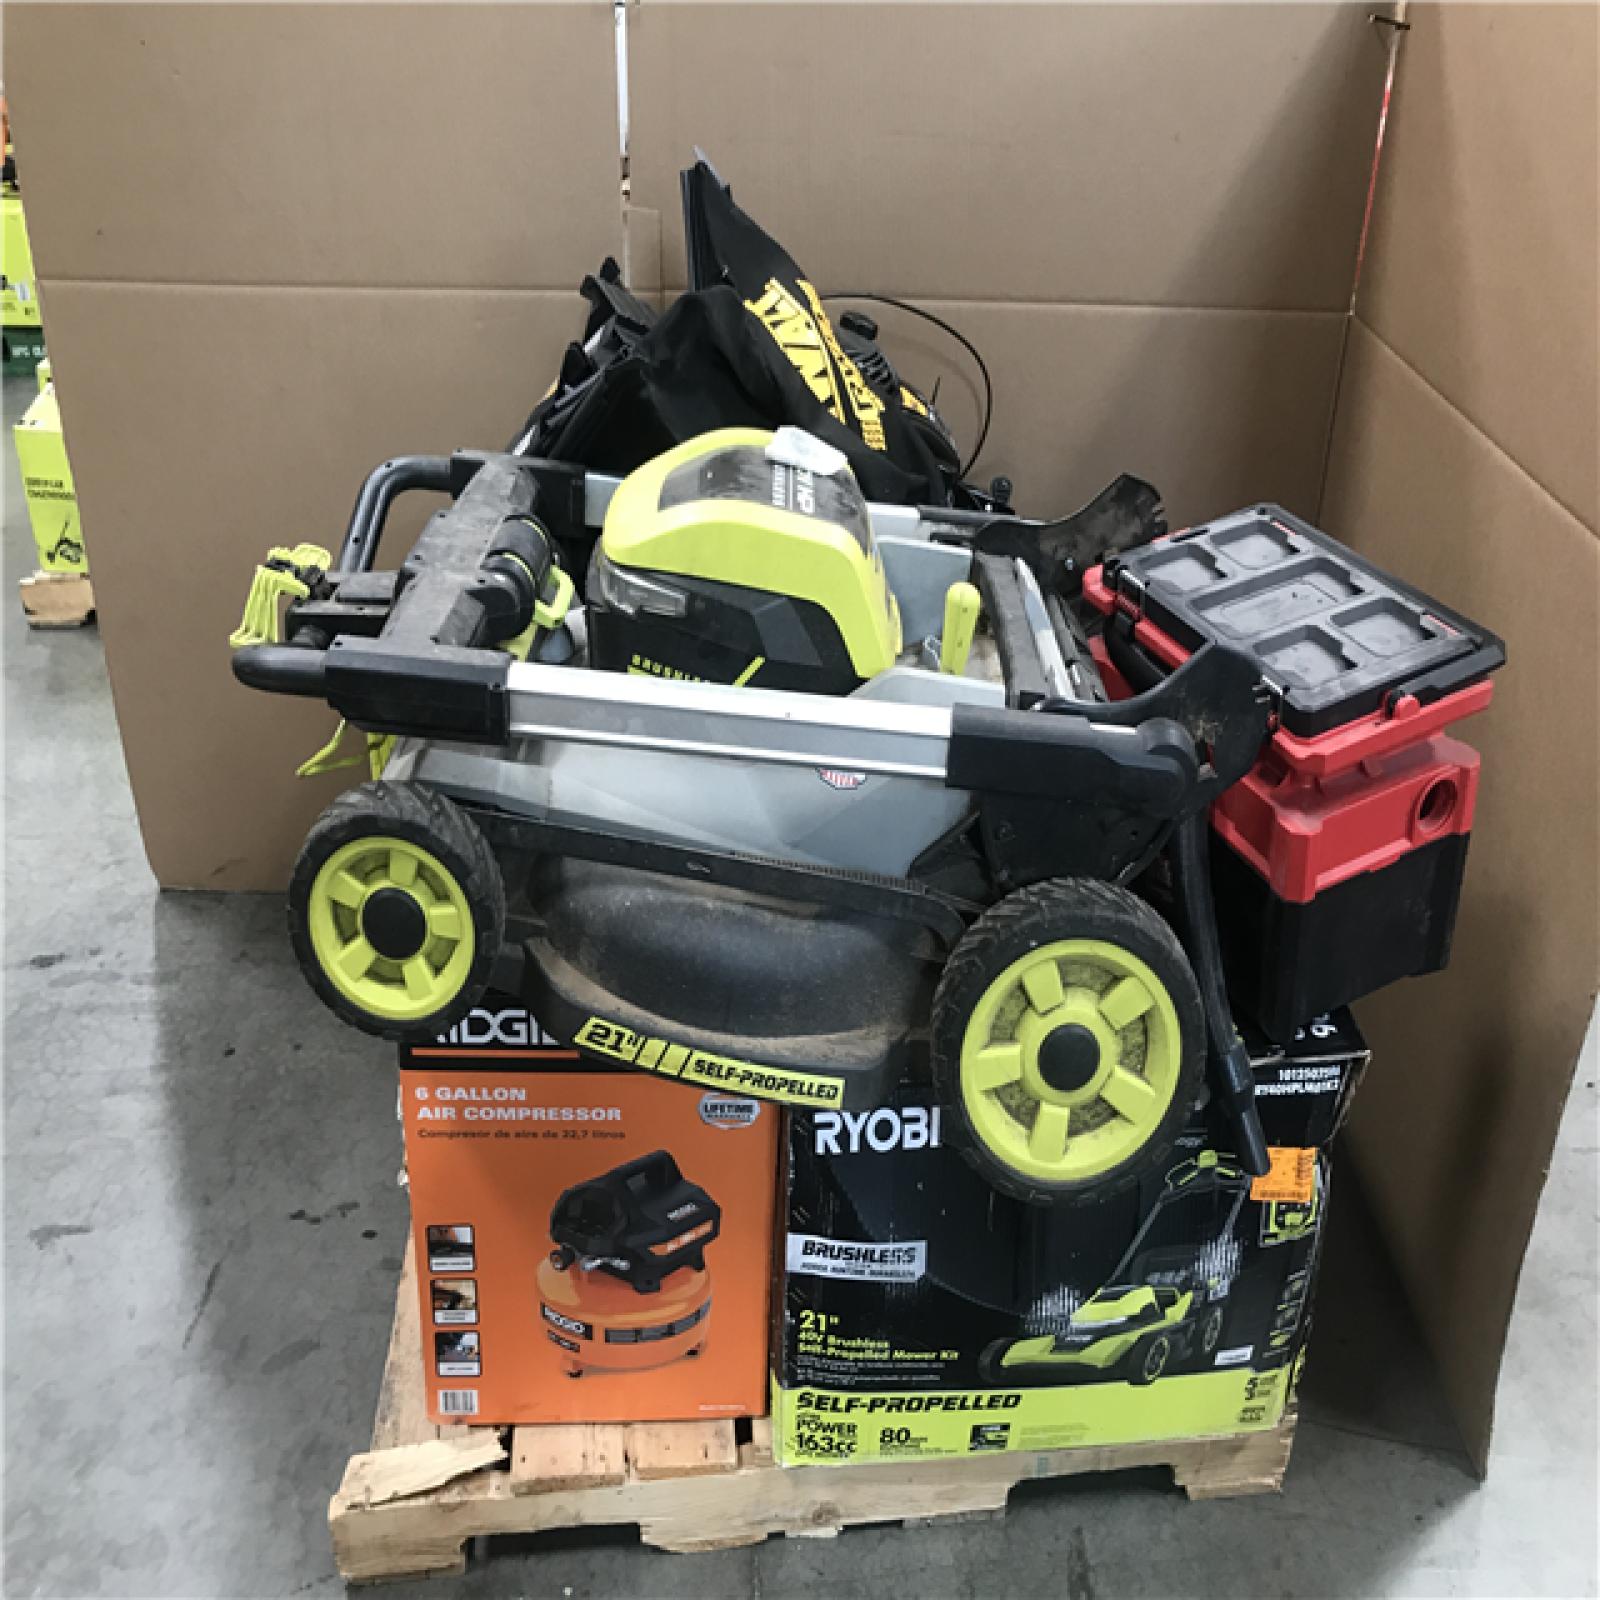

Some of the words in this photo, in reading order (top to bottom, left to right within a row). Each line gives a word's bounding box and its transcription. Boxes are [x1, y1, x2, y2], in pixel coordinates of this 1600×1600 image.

[585, 1023, 638, 1053] 21"
[693, 1058, 839, 1100] SELF-PROPELLED
[414, 1087, 429, 1100] 6
[435, 1087, 526, 1100] GALLON
[417, 1107, 456, 1121] AIR
[464, 1107, 621, 1121] COMPRESSOR
[494, 1129, 510, 1138] de
[813, 1106, 941, 1156] RYOBI
[800, 1309, 841, 1333] 21"
[827, 1334, 890, 1349] Brushless
[892, 1349, 938, 1361] Mower
[939, 1350, 961, 1361] Kit
[796, 1391, 1024, 1414] SELF-PROPELLED
[796, 1417, 858, 1438] POWER
[880, 1426, 911, 1444] 80
[796, 1432, 857, 1455] 163cc
